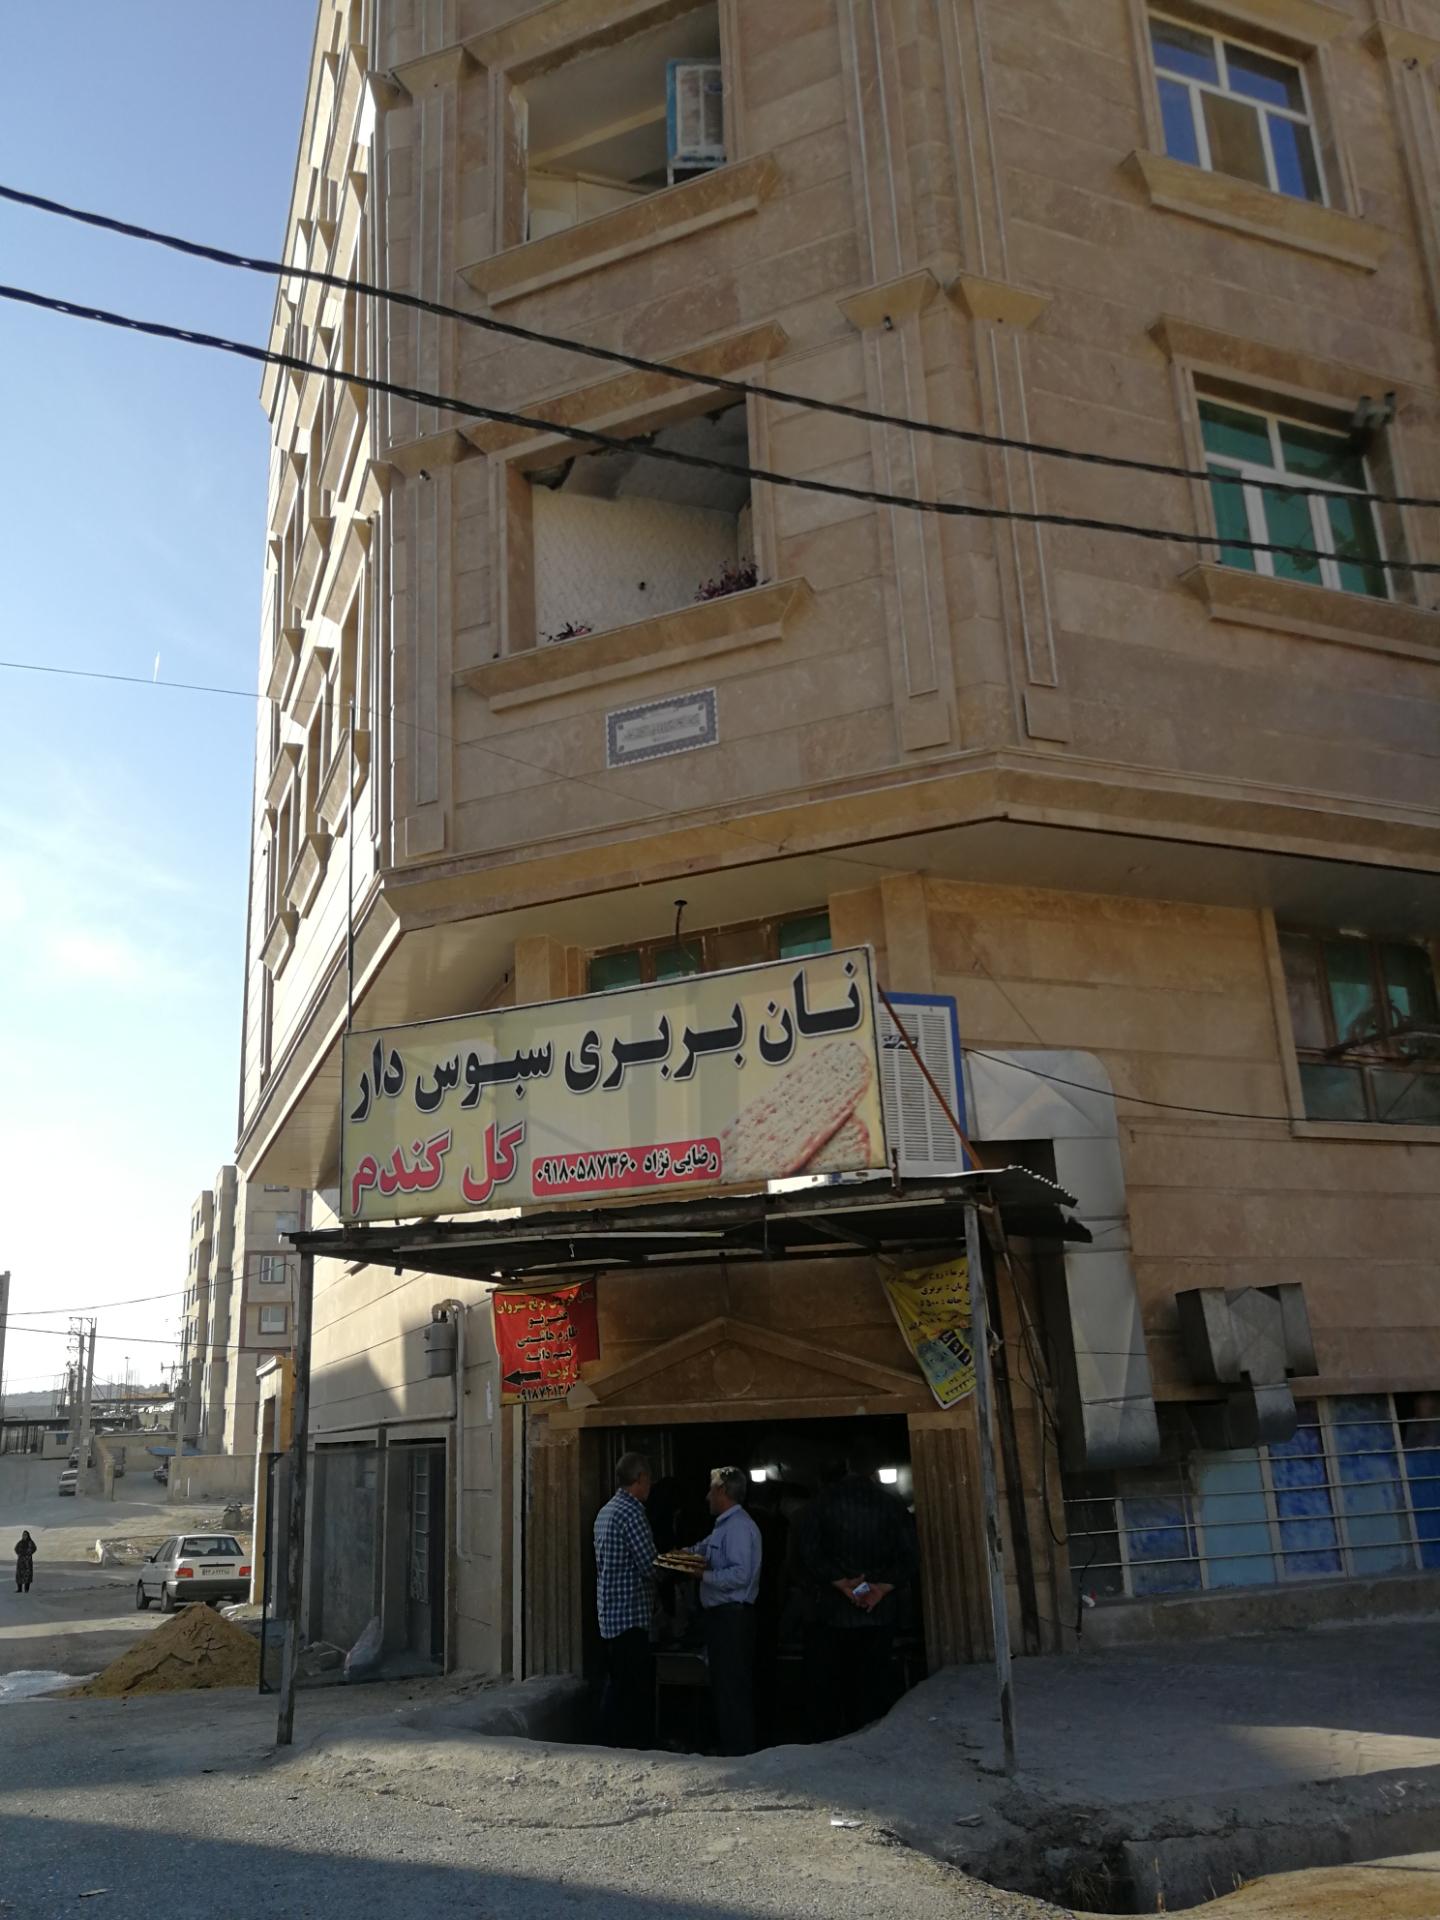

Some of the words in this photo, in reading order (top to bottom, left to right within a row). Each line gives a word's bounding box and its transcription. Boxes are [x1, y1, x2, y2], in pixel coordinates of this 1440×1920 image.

[564, 1001, 747, 1094] بربری
[758, 958, 864, 1065] نان
[350, 1037, 404, 1121] دار
[413, 1039, 555, 1113] سبوس
[350, 1129, 451, 1217] گندم
[460, 1119, 526, 1205] گل
[535, 1153, 638, 1186] ۰۹۱۸۰۵۸۷۳۶۰
[643, 1150, 670, 1179] نژاد
[672, 1145, 718, 1176] رضایی
